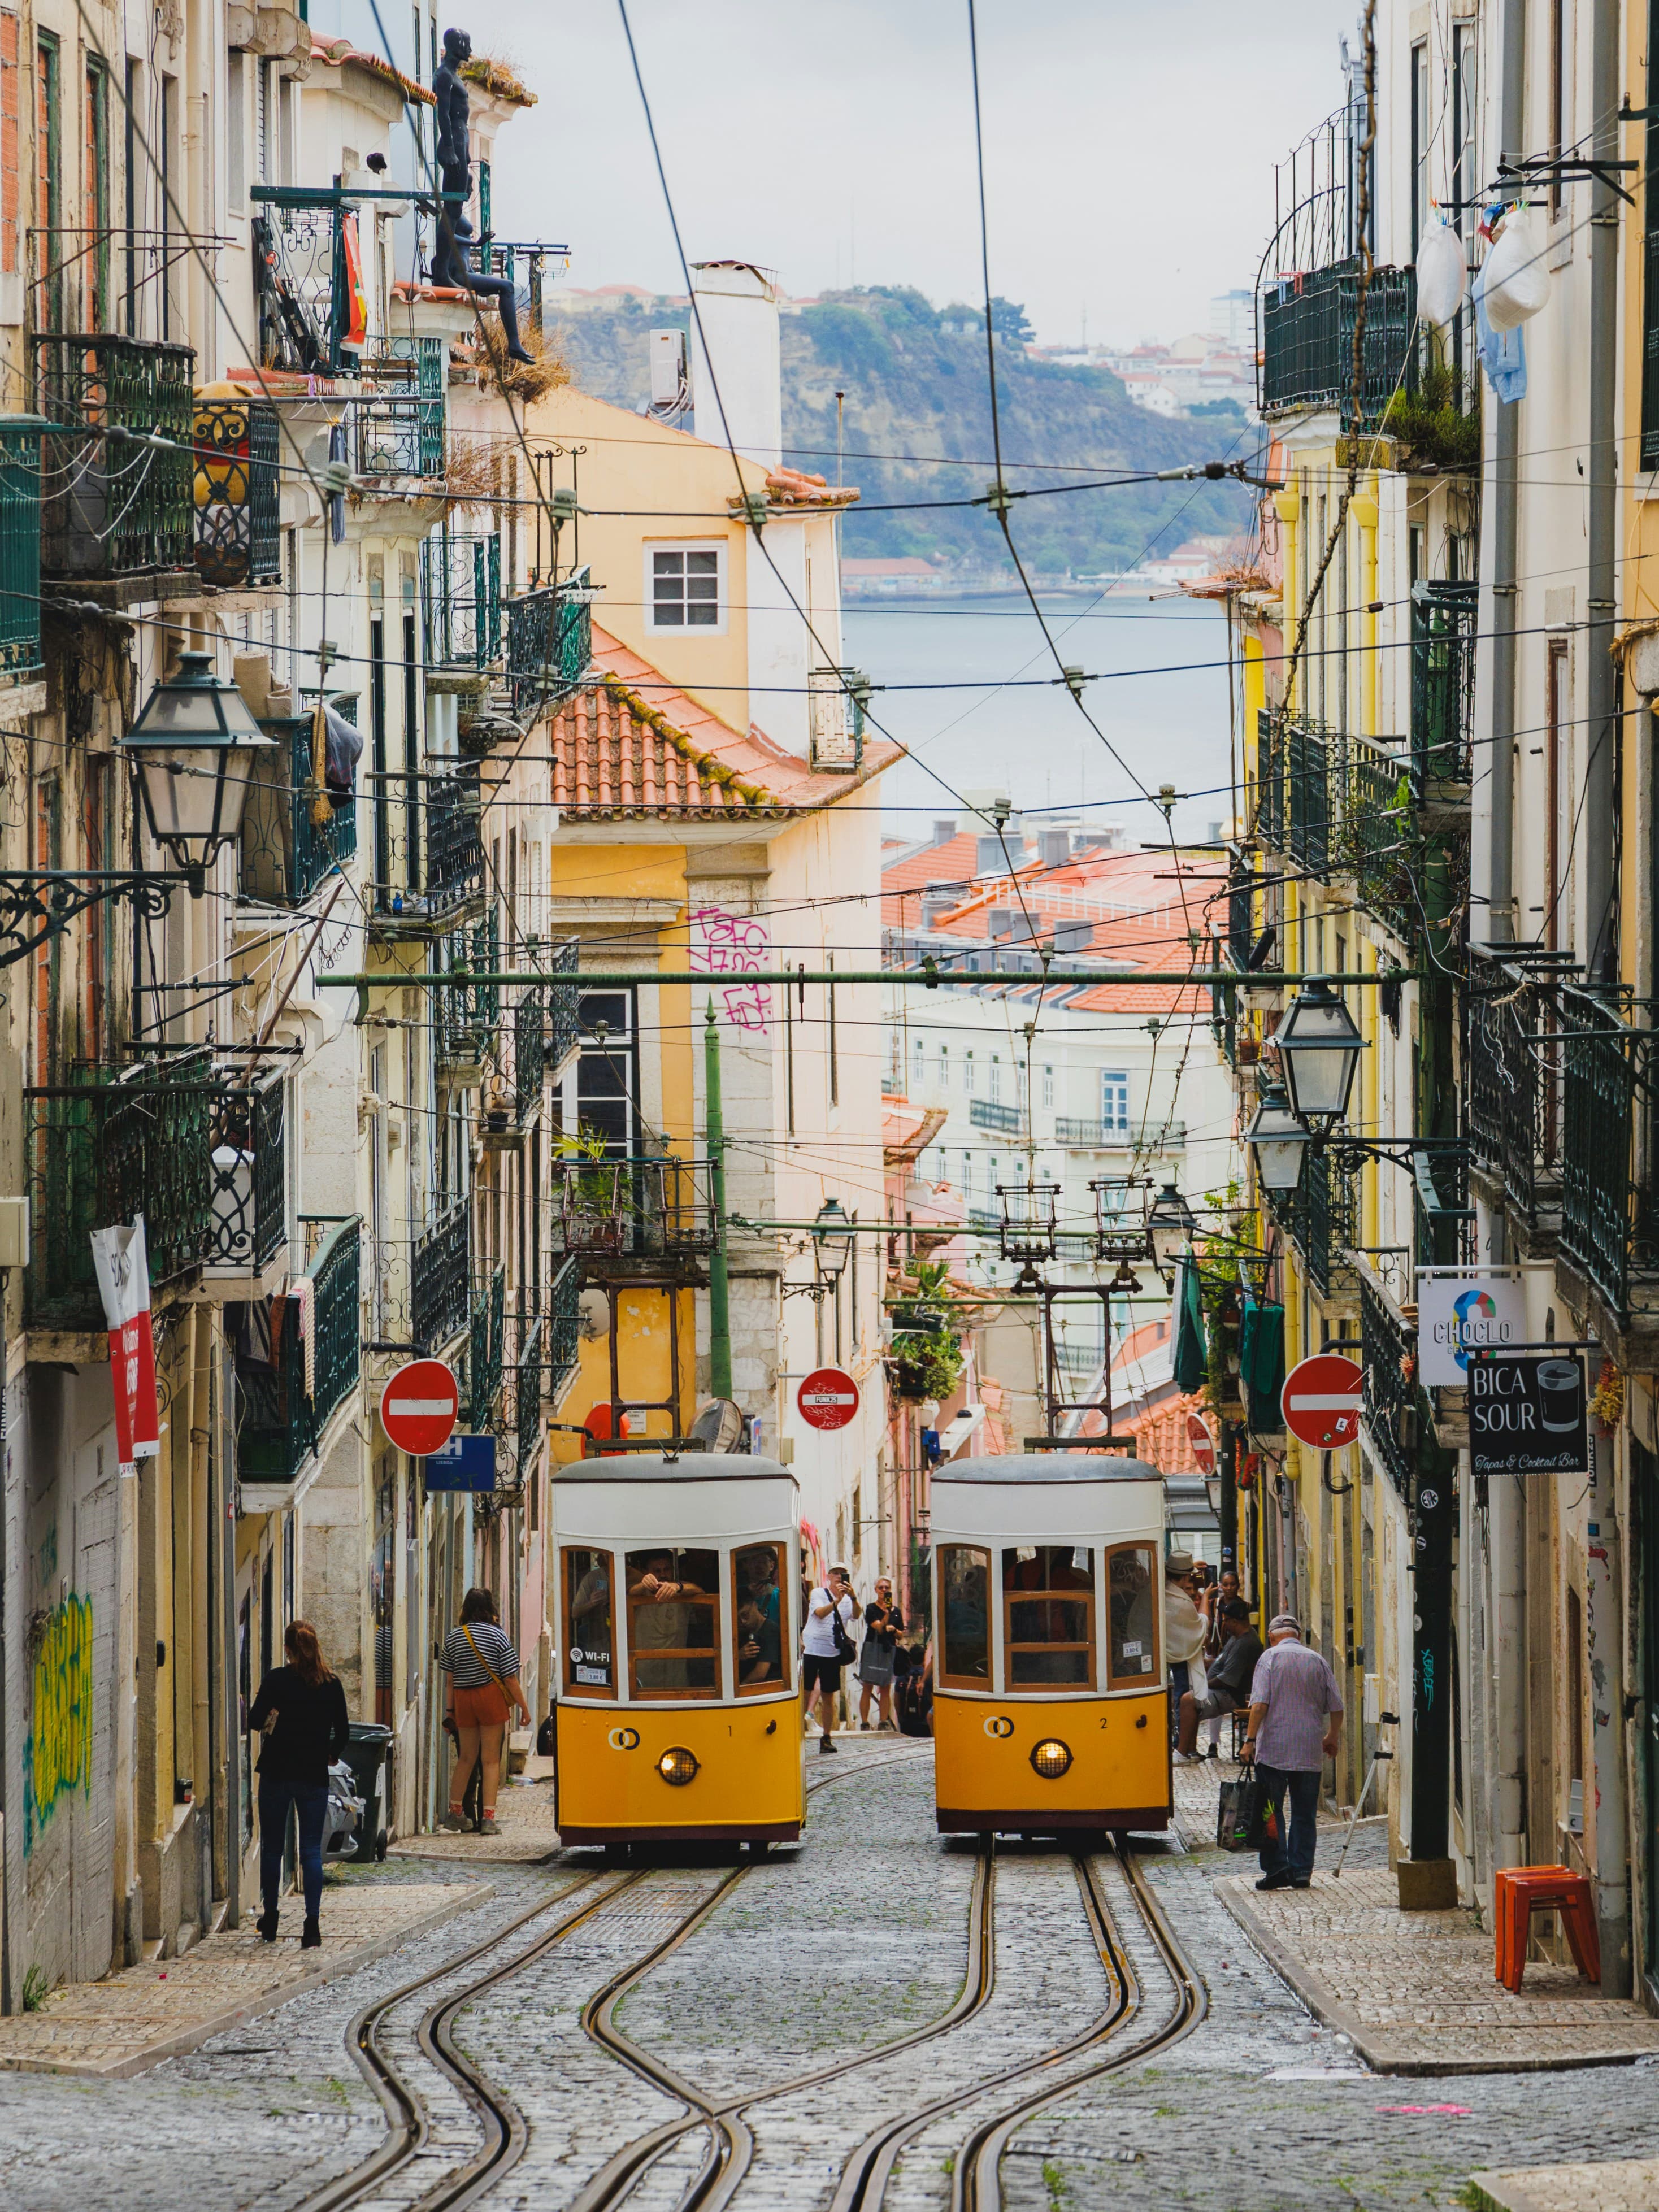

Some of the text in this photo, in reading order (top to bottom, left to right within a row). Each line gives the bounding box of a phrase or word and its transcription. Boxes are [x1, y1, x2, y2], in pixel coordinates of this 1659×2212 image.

[1434, 1320, 1513, 1343] CHOCLO
[1474, 1367, 1526, 1396] BICA
[1475, 1403, 1536, 1432] SOUR
[1475, 1452, 1580, 1472] Tapas & Cocktail Bar
[585, 1651, 610, 1662] WI-FI
[727, 1725, 732, 1737] 1
[1100, 1718, 1108, 1729] 2
